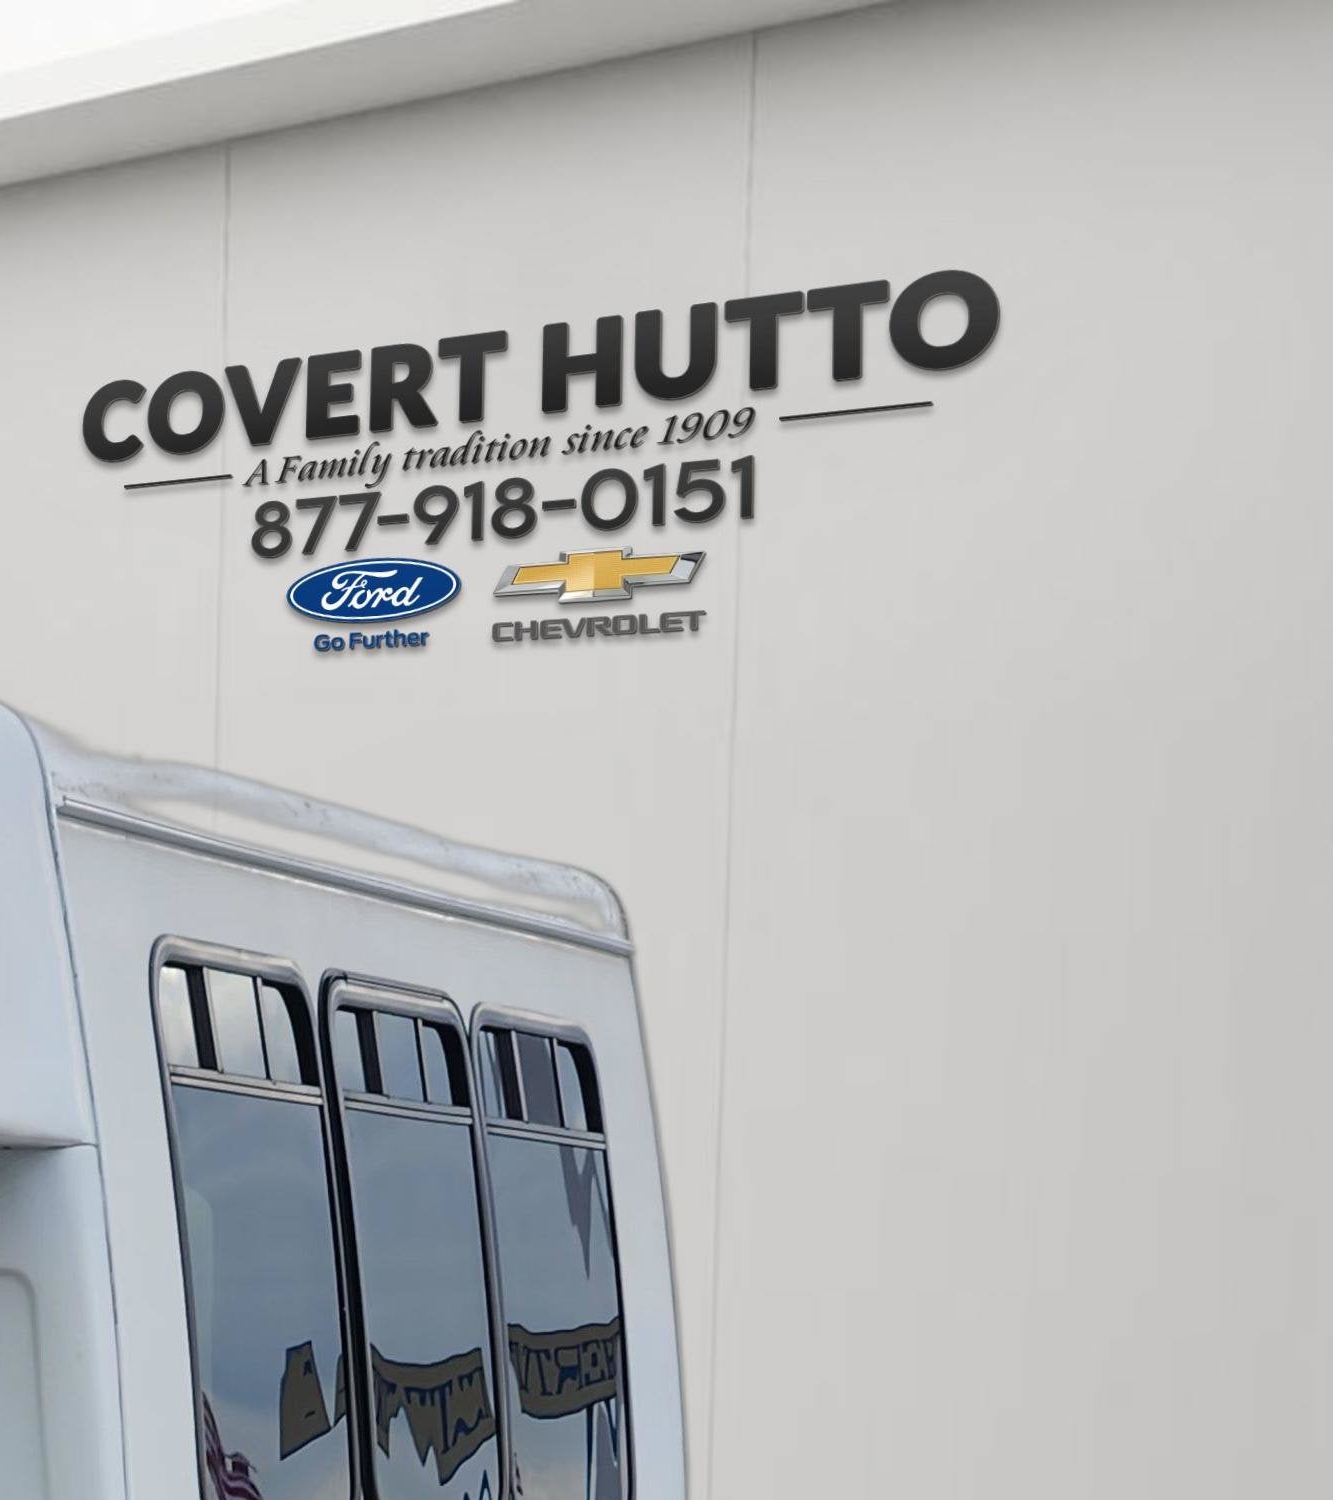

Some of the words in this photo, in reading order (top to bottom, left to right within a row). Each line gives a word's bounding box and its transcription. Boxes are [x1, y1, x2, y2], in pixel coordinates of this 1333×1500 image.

[83, 331, 509, 464] COVERT
[542, 270, 1001, 415] HUTTO
[243, 458, 269, 488] A
[276, 441, 391, 489] Family
[403, 430, 551, 472] tradition
[561, 424, 649, 456] since
[657, 407, 756, 446] 1909
[252, 455, 756, 560] 877-918-0151
[321, 569, 421, 612] Ford
[314, 634, 346, 653] Go
[349, 629, 430, 651] Further
[491, 611, 707, 643] CHEVROLET
